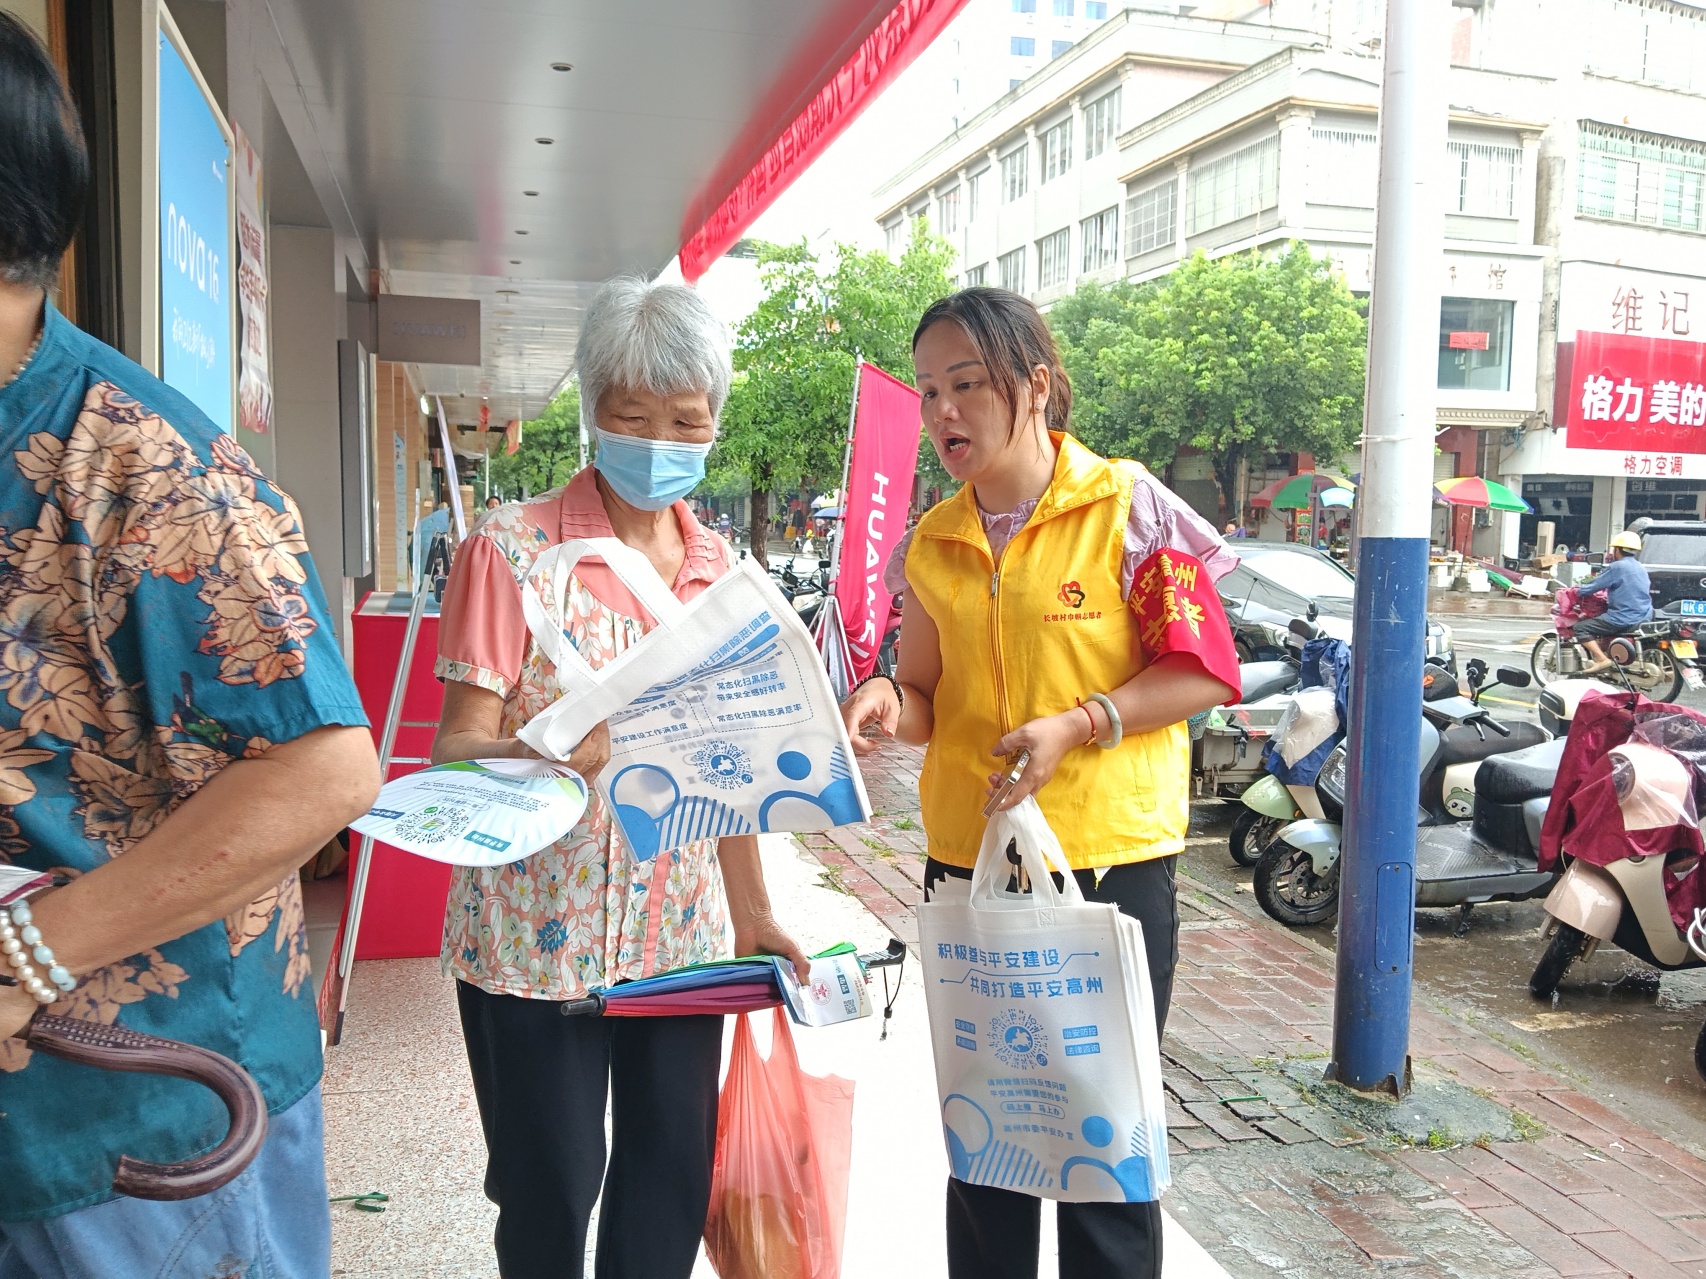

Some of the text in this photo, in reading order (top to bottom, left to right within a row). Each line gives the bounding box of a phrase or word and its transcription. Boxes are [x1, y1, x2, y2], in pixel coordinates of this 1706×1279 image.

[167, 202, 205, 293] nova
[1611, 285, 1690, 336] 维记
[1580, 374, 1706, 427] 格力 美的
[1623, 454, 1683, 476] 格力空调
[716, 670, 778, 691] 常态化扫黑除恶
[716, 703, 802, 723] 常态化扫黑除恶满意率
[611, 722, 689, 745] 平安建设工作满意度
[937, 943, 1060, 969] 积极参与平安建设
[970, 976, 1104, 999] 共同打造平安高州
